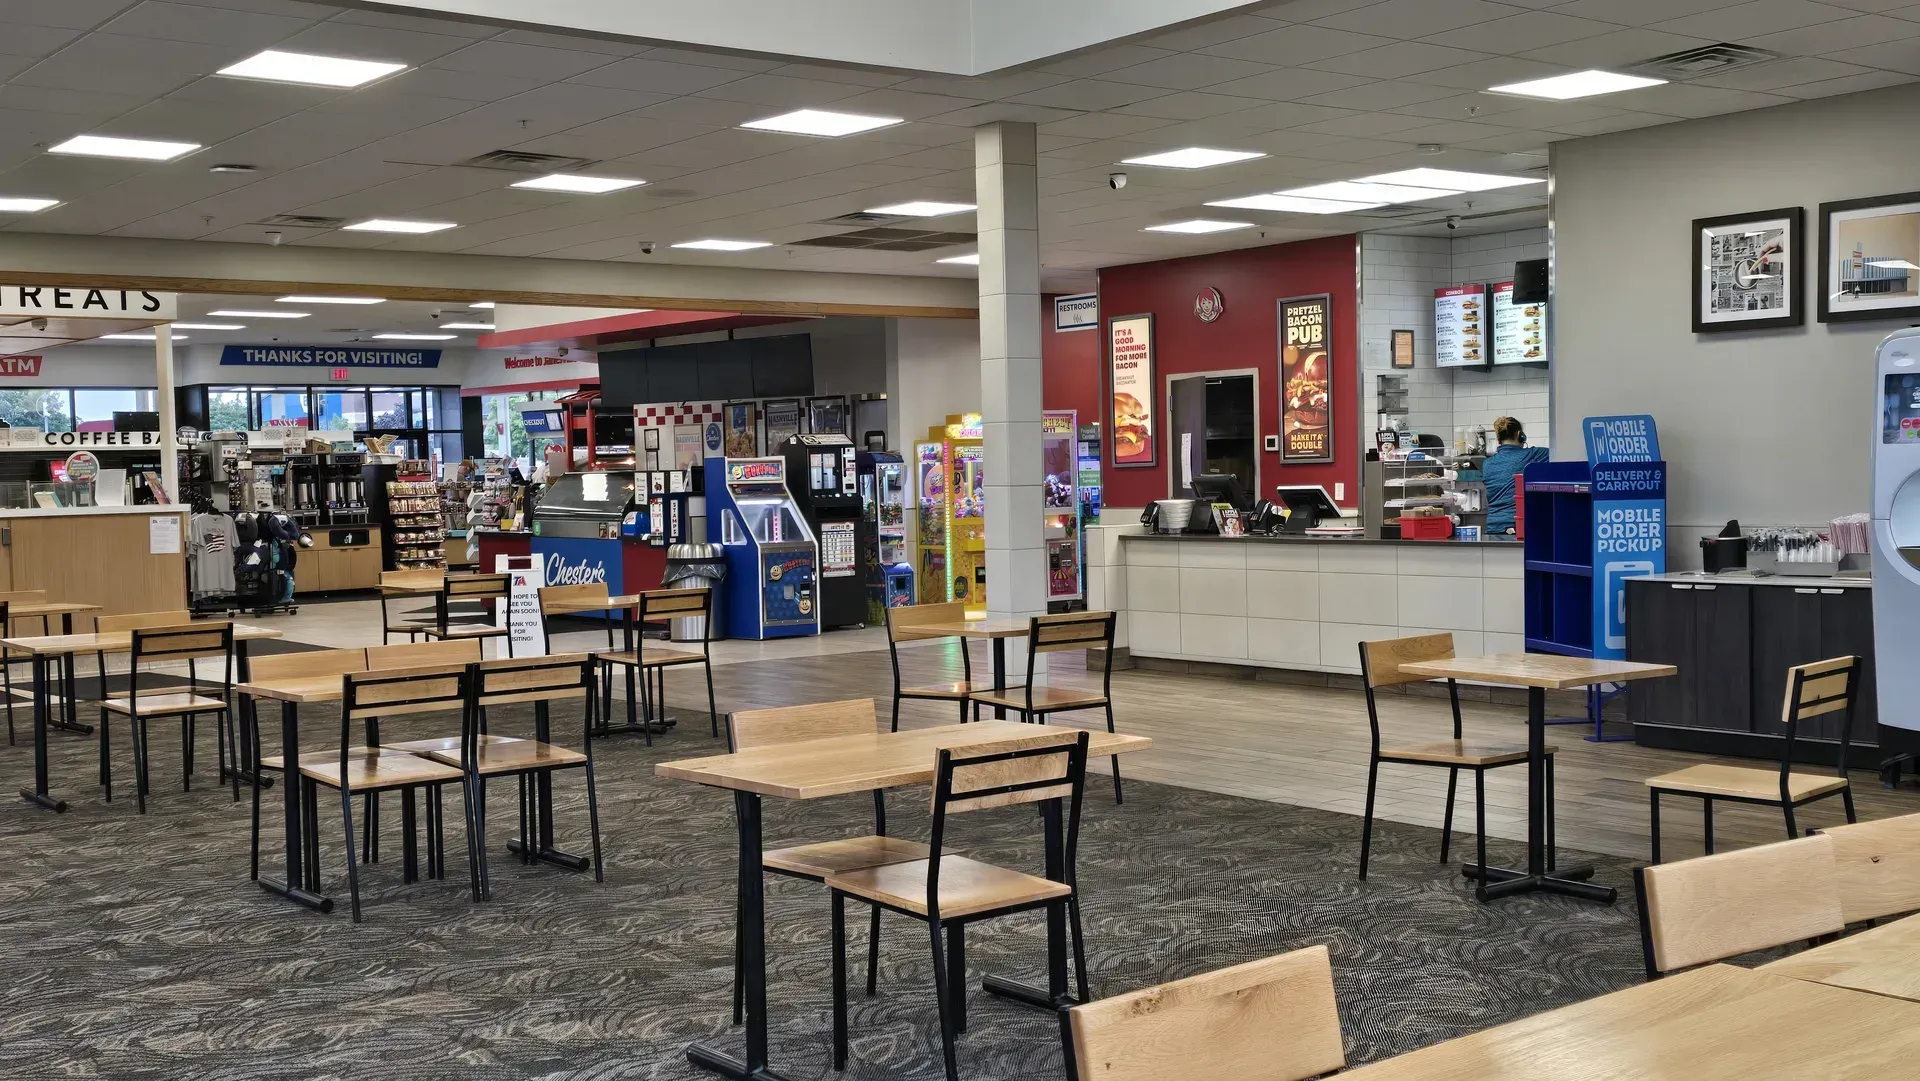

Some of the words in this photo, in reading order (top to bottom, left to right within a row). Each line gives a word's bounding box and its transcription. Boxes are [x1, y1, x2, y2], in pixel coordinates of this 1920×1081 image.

[0, 287, 160, 312] REATS
[1059, 301, 1097, 312] RESTROOMS
[1287, 304, 1323, 316] PRETZEL
[1287, 314, 1323, 326] BACON
[1115, 329, 1126, 337] IT'S
[1287, 325, 1323, 345] PUB
[1115, 337, 1134, 345] GOOD
[1115, 344, 1146, 353] MORNING
[243, 349, 312, 363] THANKS
[315, 351, 347, 363] FOR
[350, 351, 422, 364] VISITING!
[1129, 352, 1147, 360] MORE
[504, 357, 534, 369] Welcome
[1116, 361, 1138, 370] BACON
[1605, 420, 1647, 436] MOBILE
[44, 431, 130, 445] COFFEE
[1291, 434, 1310, 442] MAKE
[1310, 433, 1317, 441] IT
[1291, 441, 1323, 450] DOUBLE
[1609, 437, 1650, 454] ORDER
[1596, 470, 1651, 481] DELIVERY
[1654, 470, 1662, 480] &
[1597, 481, 1661, 491] CARRYOUT
[1597, 508, 1661, 523] MOBILE
[1597, 523, 1660, 539] ORDER
[1597, 538, 1662, 553] PICKUP
[546, 552, 606, 586] Chester's
